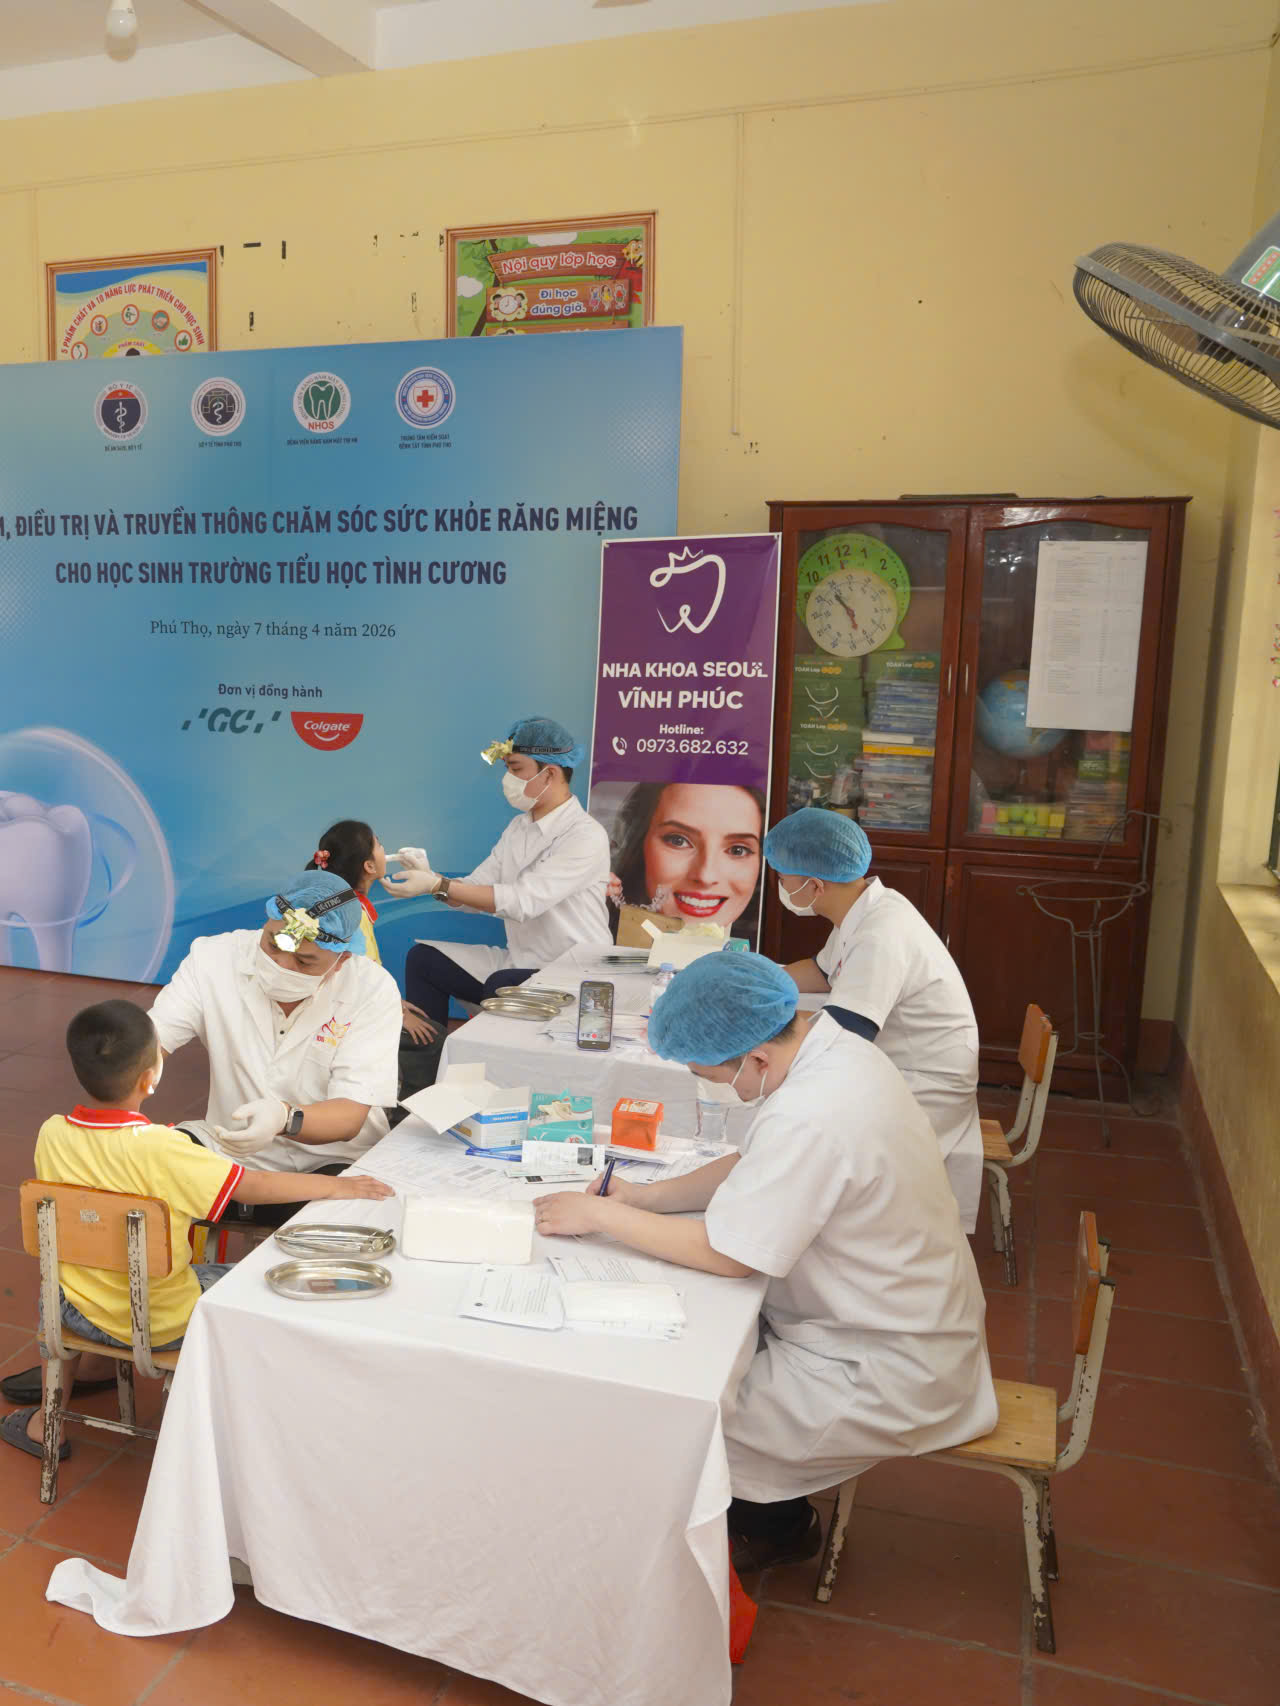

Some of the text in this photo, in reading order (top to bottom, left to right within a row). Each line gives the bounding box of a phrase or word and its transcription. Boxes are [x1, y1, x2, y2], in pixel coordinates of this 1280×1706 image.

[501, 252, 617, 275] Nội quy lớp học
[540, 288, 578, 301] Đi học
[531, 302, 561, 317] đúng
[173, 298, 187, 314] CHO
[192, 325, 205, 346] SINH
[308, 421, 334, 430] NHOS
[15, 508, 56, 537] ĐIỀU
[60, 513, 89, 540] TRỊ
[94, 508, 120, 536] VÀ
[123, 505, 196, 536] TRUYỀN
[202, 506, 268, 535] THÔNG
[272, 505, 331, 534] CHĂM
[337, 504, 377, 533] SÓC
[383, 503, 429, 533] SỨC
[435, 500, 491, 533] KHỎE
[497, 502, 559, 532] RĂNG
[565, 500, 638, 536] MIỆNG
[834, 544, 852, 558] 12
[817, 553, 831, 566] 11
[879, 558, 888, 571] 2
[55, 553, 507, 589] CHO HỌC SINH TRƯỜNG TIỂU HỌC TÌNH CƯƠNG
[805, 570, 820, 584] 10
[150, 620, 396, 640] Phú Thọ, ngày 7 tháng 4 năm 2026
[602, 661, 768, 678] NHA KHOA SEOUL
[218, 682, 323, 699] Đơn vị đồng hành
[618, 686, 744, 710] VĨNH PHÚC
[303, 719, 352, 733] Colgate
[659, 723, 705, 736] Hotline:
[636, 738, 749, 756] 0973.682.632
